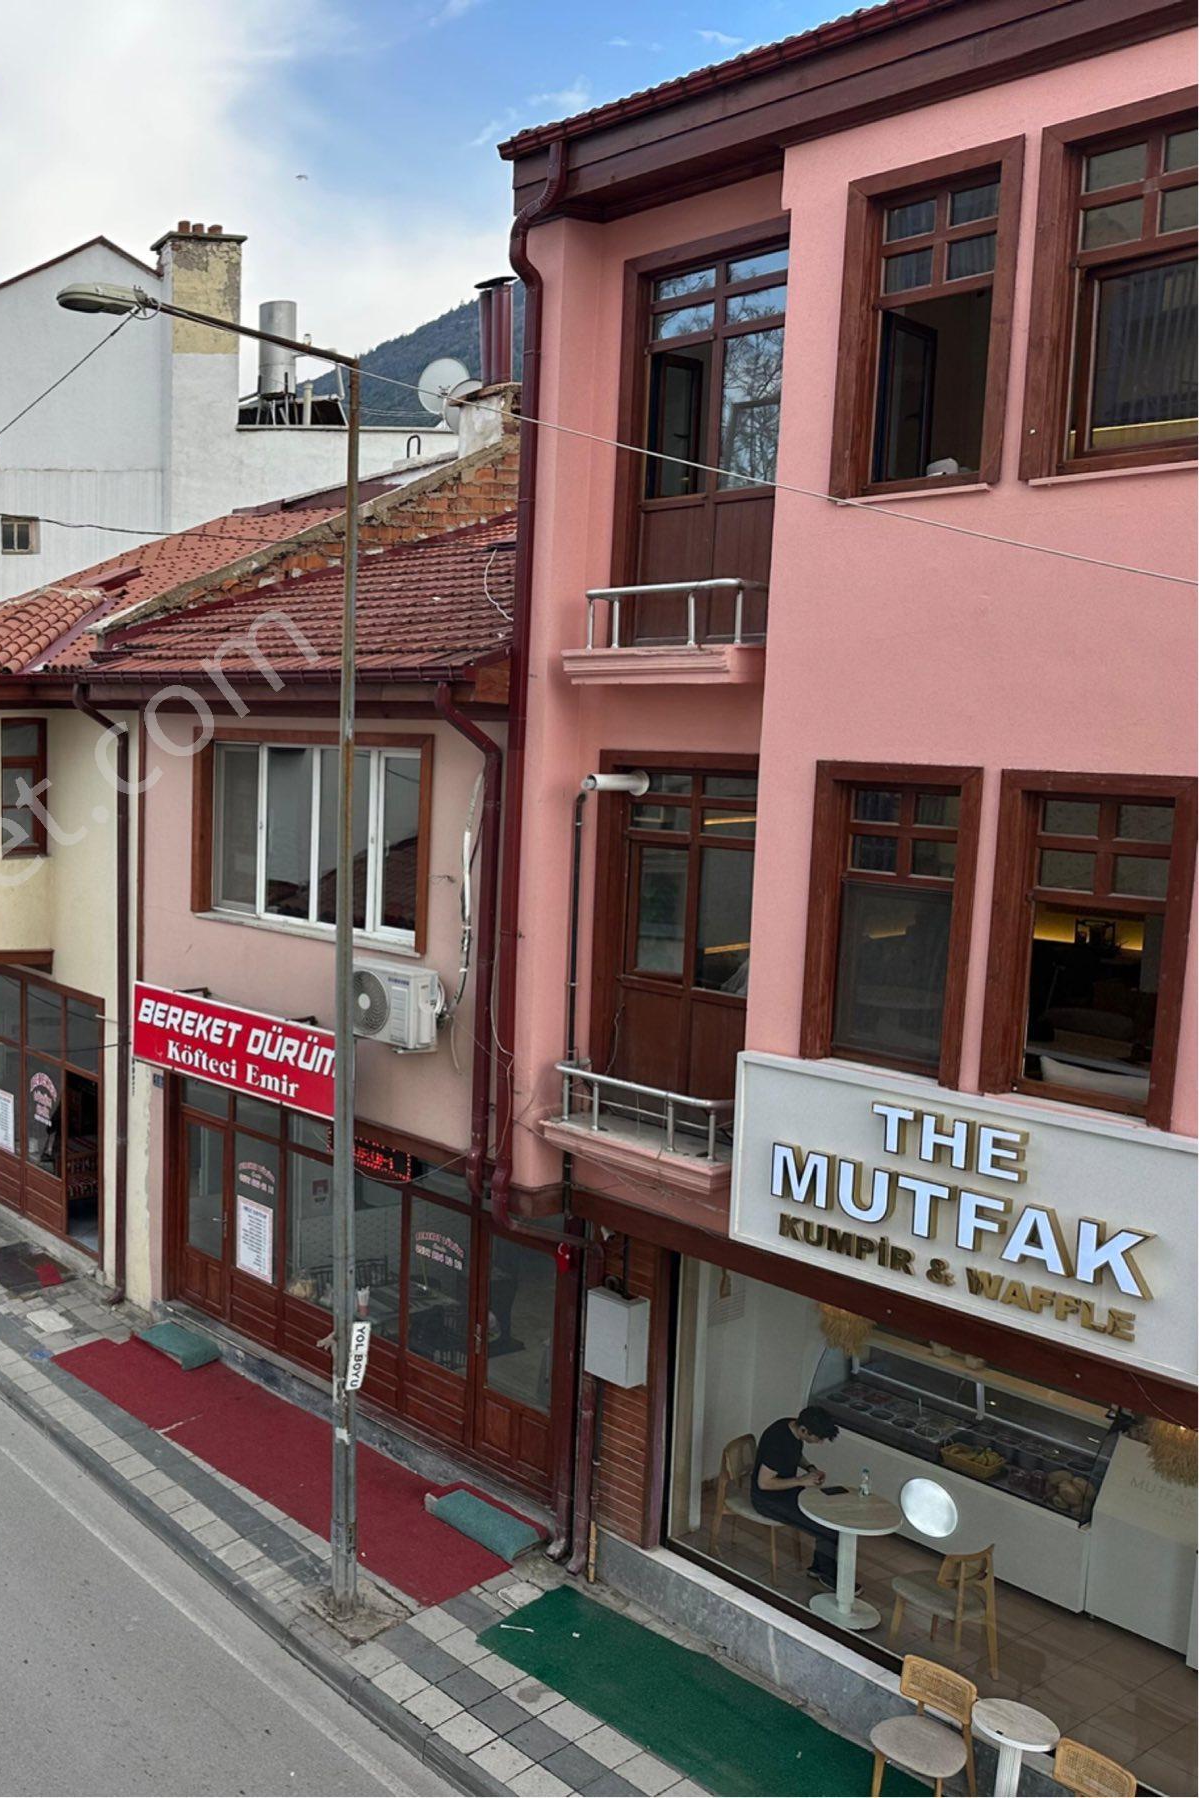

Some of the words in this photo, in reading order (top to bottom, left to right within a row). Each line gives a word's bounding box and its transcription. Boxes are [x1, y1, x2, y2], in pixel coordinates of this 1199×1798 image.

[138, 997, 242, 1048] BEREKET
[246, 1026, 335, 1078] DÜRÜM
[167, 1039, 237, 1080] Köfteci
[245, 1062, 300, 1098] Emir
[871, 1100, 1029, 1184] THE
[770, 1141, 1156, 1301] MUTFAK
[778, 1212, 916, 1276] KUMPİR
[926, 1257, 955, 1287] &
[965, 1266, 1137, 1342] WAFFLE
[350, 1354, 364, 1388] BOYU
[355, 1326, 367, 1351] YOL
